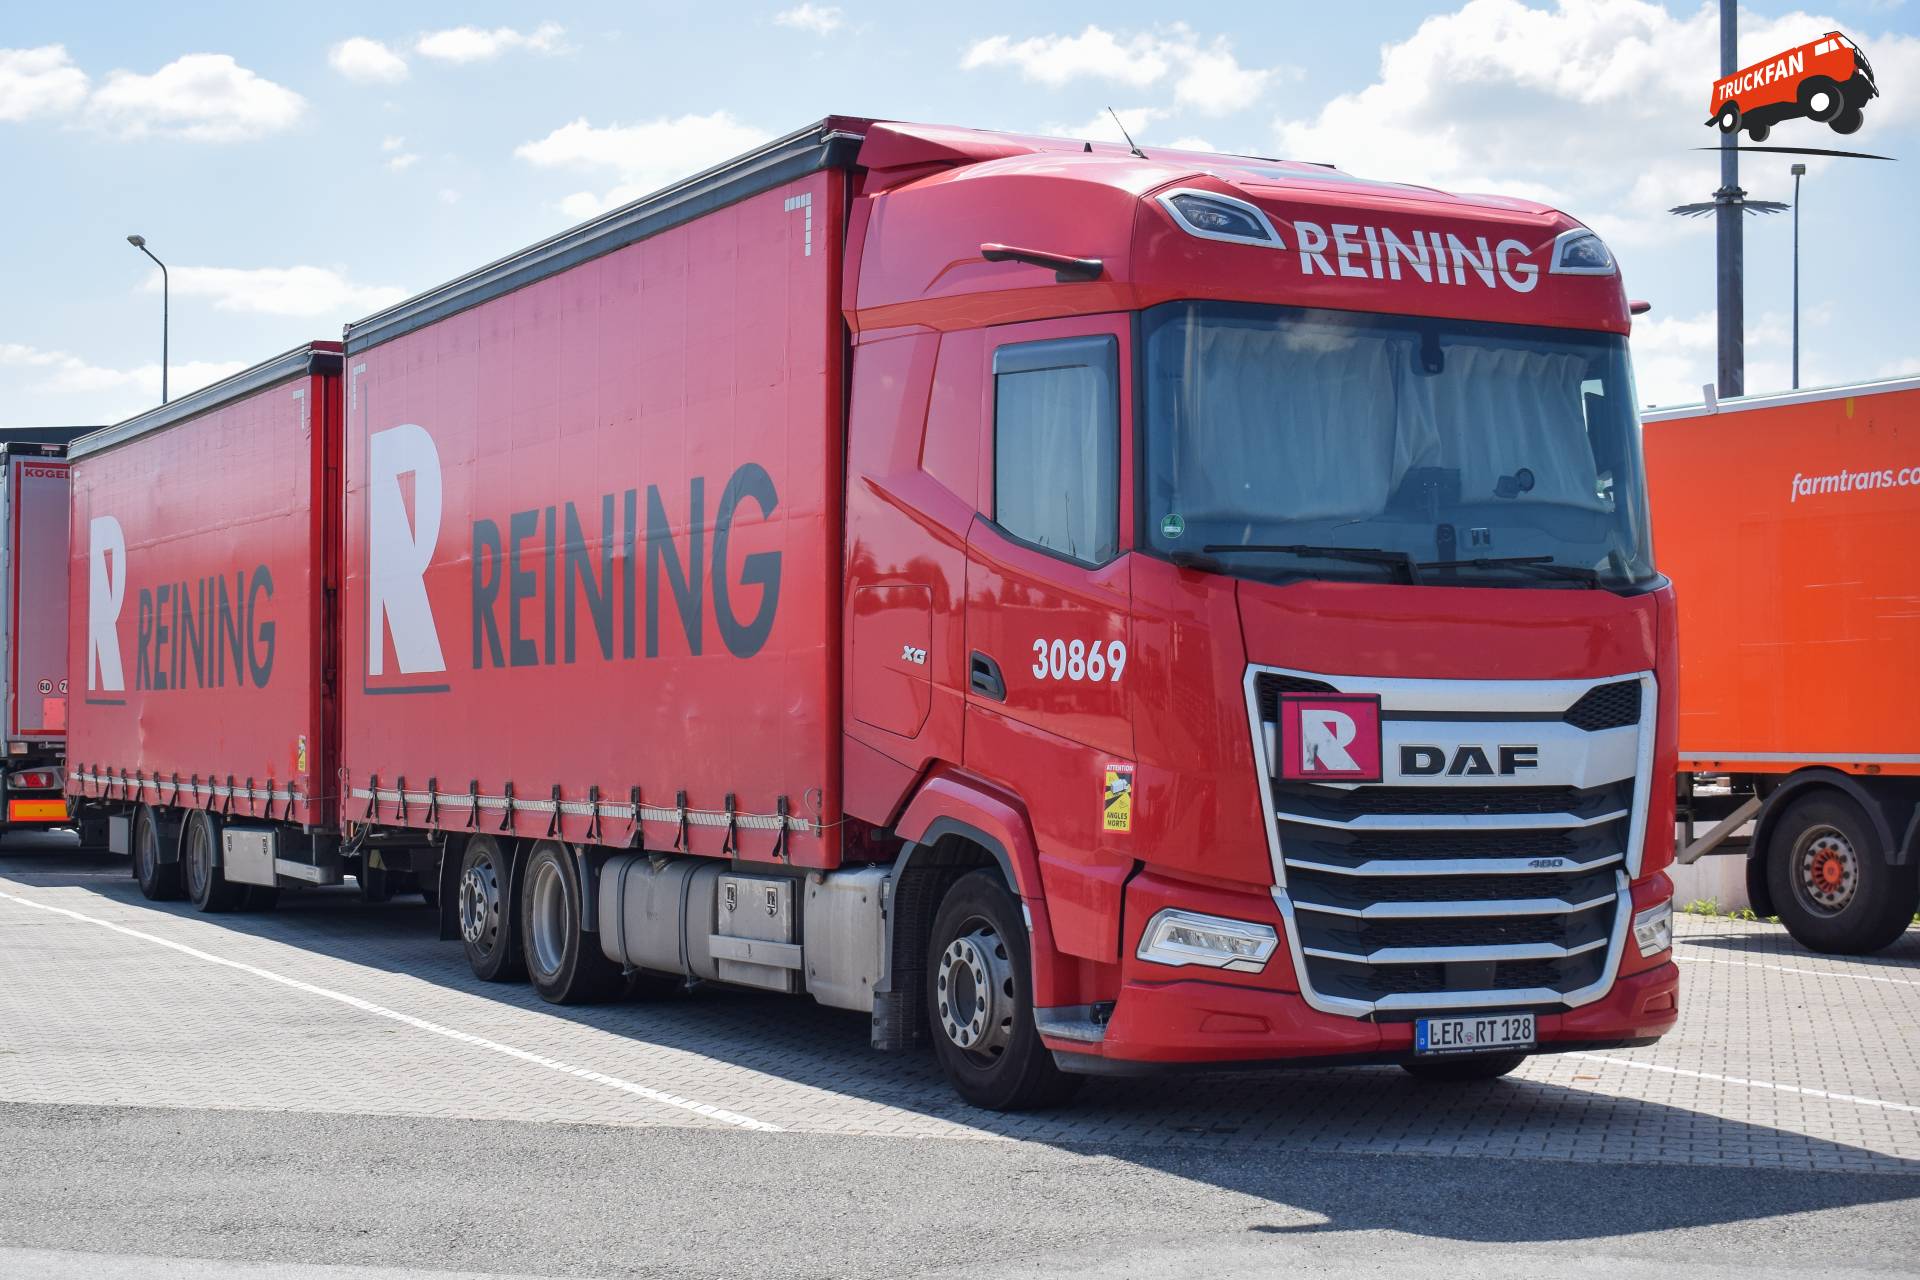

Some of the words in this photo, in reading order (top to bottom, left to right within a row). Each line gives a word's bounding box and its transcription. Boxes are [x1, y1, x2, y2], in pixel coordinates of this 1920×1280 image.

[1293, 221, 1539, 293] REINING
[368, 423, 447, 675] R
[471, 462, 783, 670] REINING
[88, 515, 126, 692] R
[135, 564, 277, 691] REINING
[901, 645, 927, 665] XG
[1032, 638, 1127, 682] 30869
[1301, 709, 1361, 771] R
[1106, 764, 1134, 772] ATTENTION
[1400, 744, 1538, 776] DAF
[1106, 811, 1128, 820] ANGLES
[1107, 819, 1127, 828] MORTS
[1528, 859, 1563, 868] 480
[1430, 1021, 1464, 1046] LER
[1476, 1020, 1497, 1043] RT
[1501, 1017, 1532, 1042] 128
